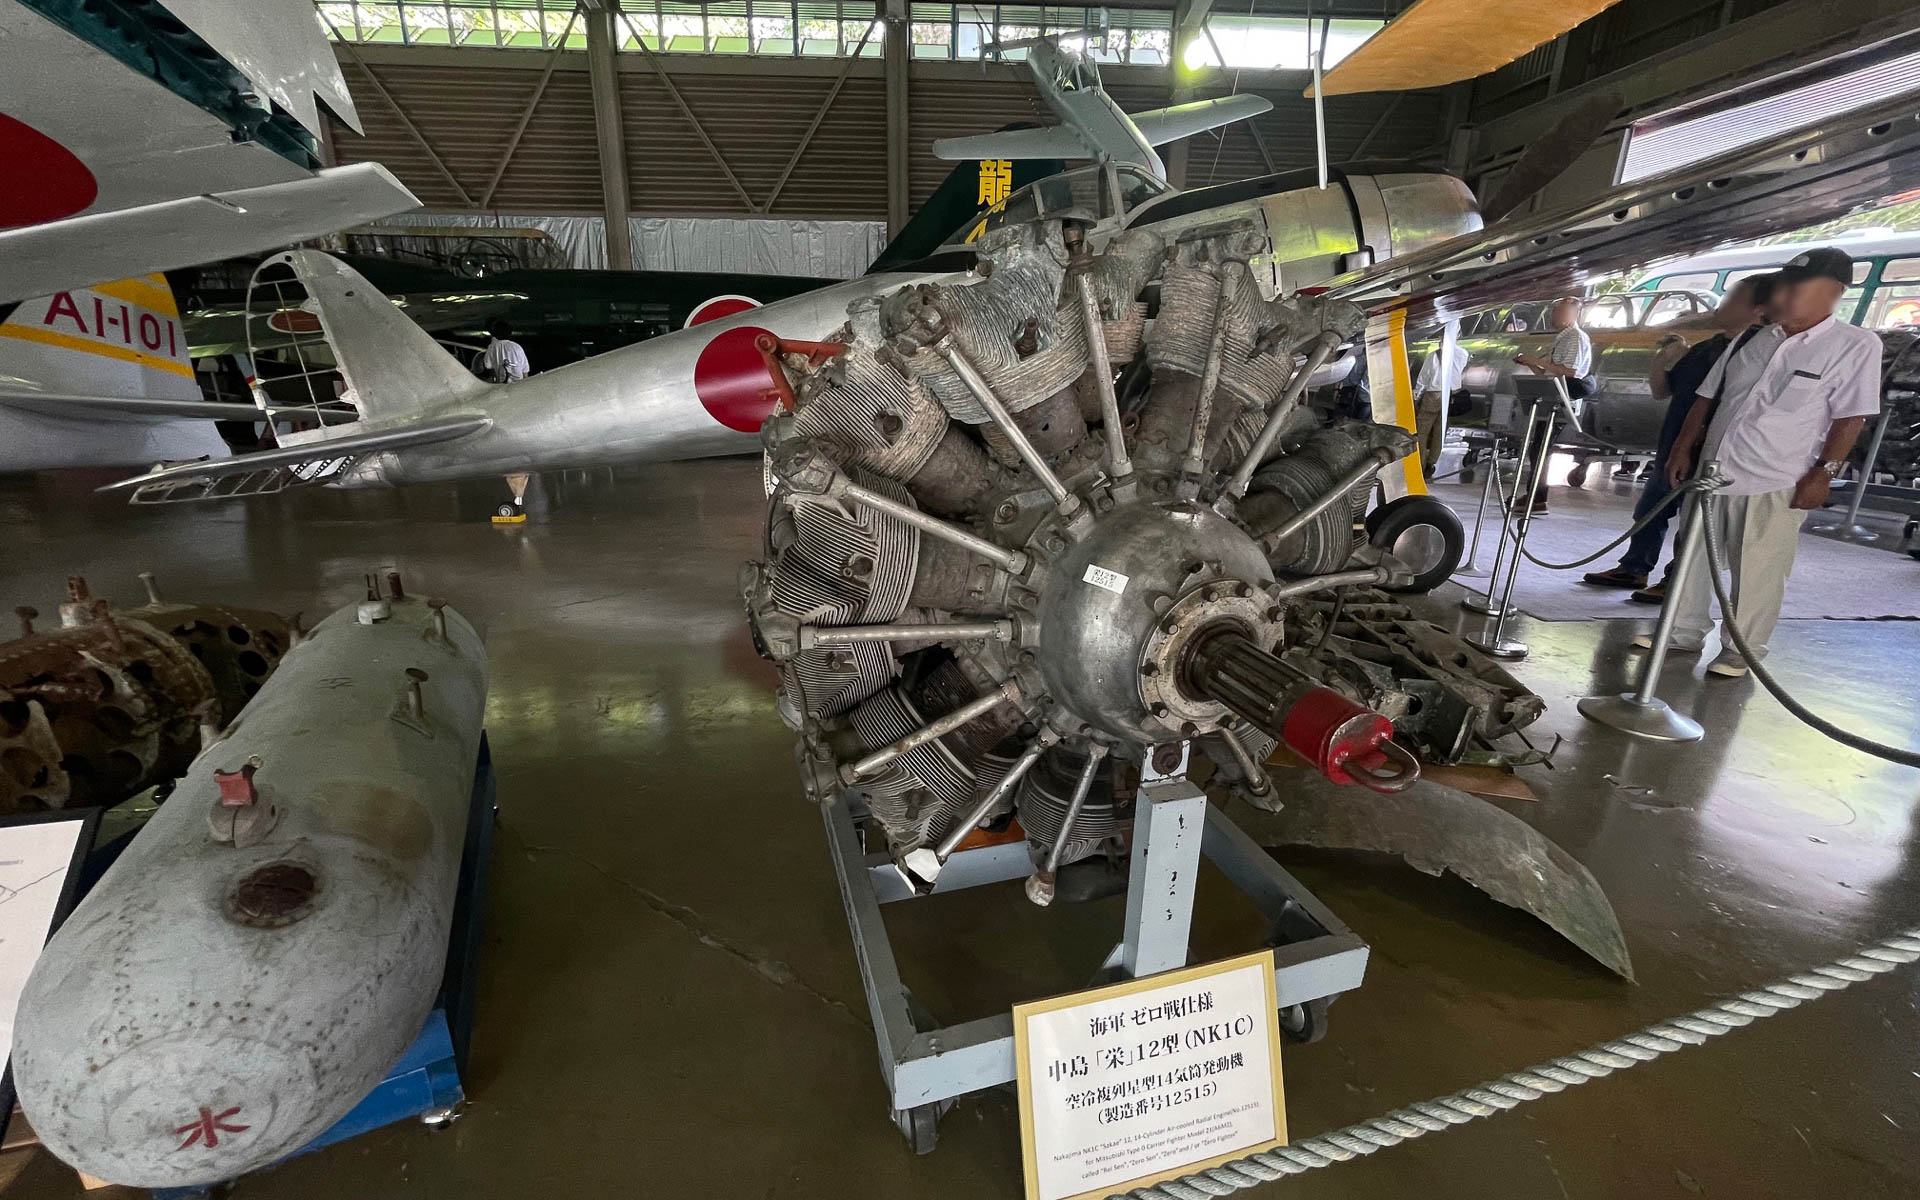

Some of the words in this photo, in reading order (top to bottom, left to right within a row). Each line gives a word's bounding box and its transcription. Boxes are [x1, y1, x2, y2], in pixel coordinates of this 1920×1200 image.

[1089, 1012, 1126, 1038] 海軍
[1130, 991, 1214, 1027] ゼロ戦仕様
[1065, 1051, 1244, 1111] 空冷複列星型14気筒発動機
[1053, 1150, 1081, 1162] Nakajima
[1083, 1144, 1099, 1155] NK1C
[1134, 1125, 1166, 1141] 14-Cylinder
[1167, 1119, 1194, 1132] Air-cooled
[1195, 1114, 1212, 1124] Radial
[1085, 1158, 1094, 1166] for
[1095, 1150, 1126, 1163] Mitsubishi
[1127, 1145, 1140, 1156] Type
[1146, 1139, 1166, 1150] Carrier
[1167, 1134, 1186, 1146] Fighter
[1187, 1128, 1205, 1138] Model
[1081, 1169, 1100, 1179] called
